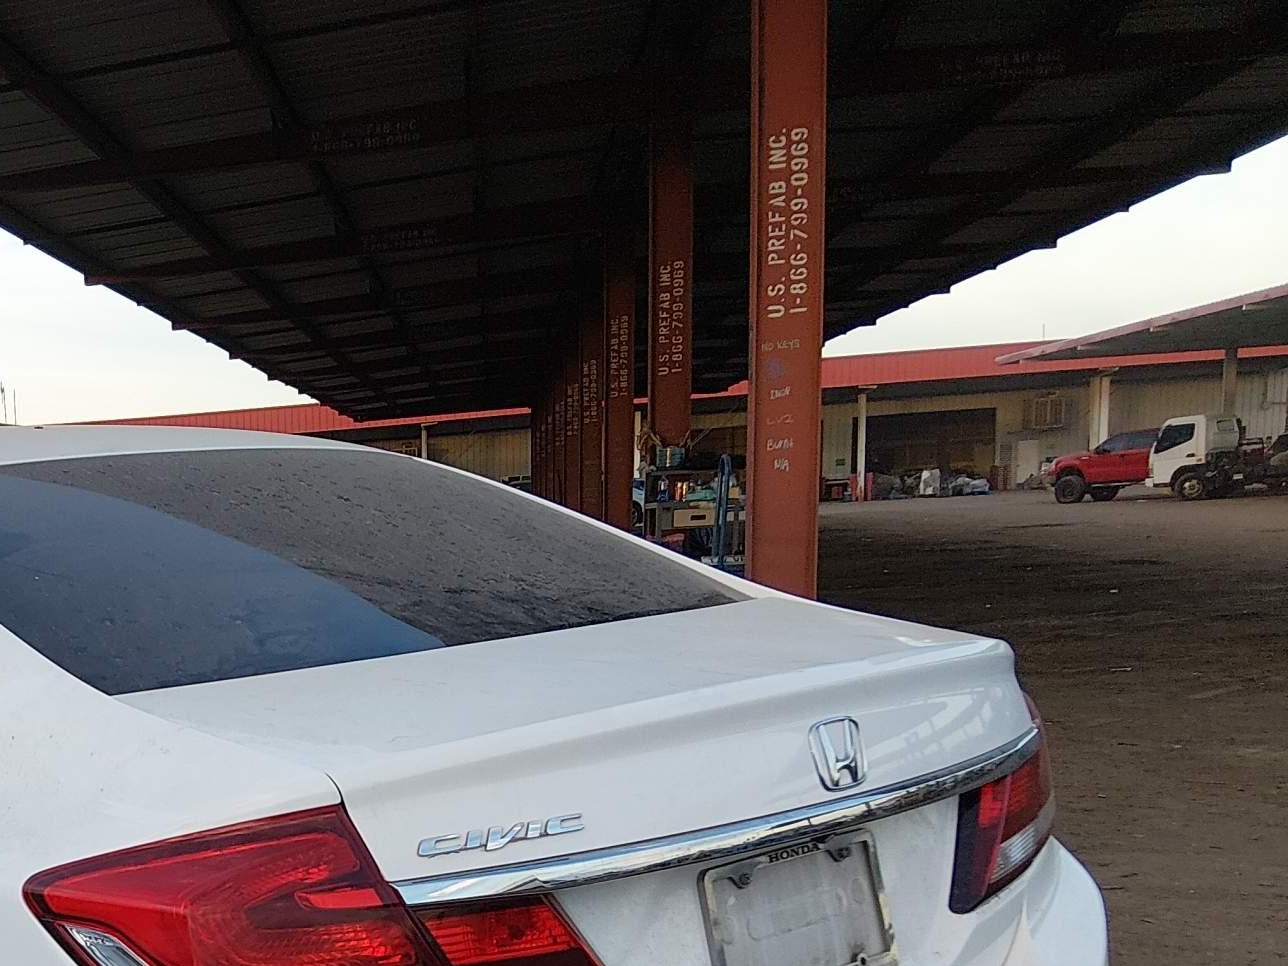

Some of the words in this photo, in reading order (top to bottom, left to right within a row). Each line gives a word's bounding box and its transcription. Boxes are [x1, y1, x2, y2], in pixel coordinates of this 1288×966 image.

[769, 127, 787, 169] INC.
[768, 180, 786, 265] PREFAB
[789, 127, 809, 313] 1-866-799-0969
[659, 292, 670, 343] PREFAB
[767, 276, 786, 318] U.S.
[658, 350, 670, 375] U.S.
[417, 813, 585, 858] CIVIC
[767, 843, 822, 864] HONDA
